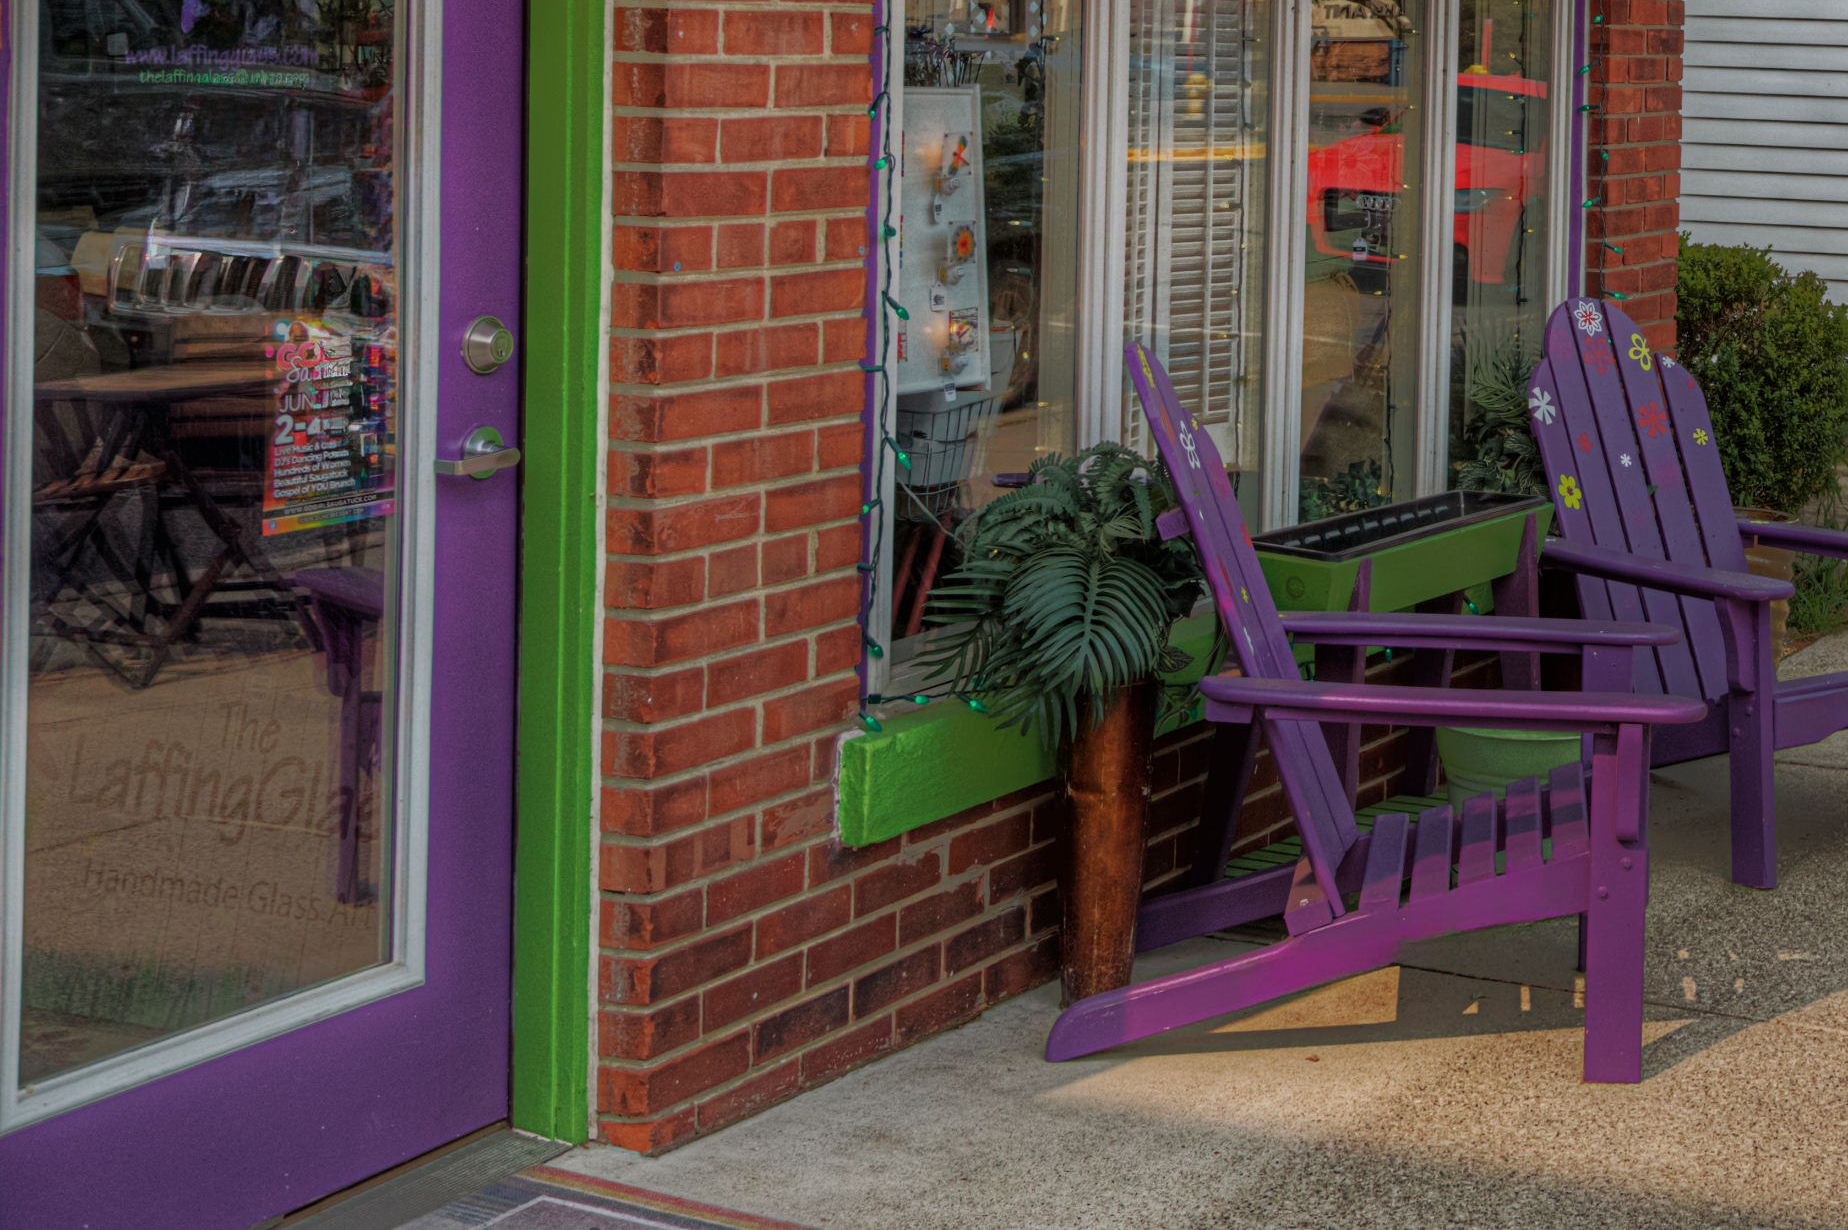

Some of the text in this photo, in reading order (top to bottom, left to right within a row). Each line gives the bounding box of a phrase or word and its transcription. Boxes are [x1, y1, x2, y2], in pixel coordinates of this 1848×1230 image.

[292, 444, 314, 454] Music
[274, 460, 352, 478] Hundreds of Women
[292, 453, 322, 466] Dancing
[273, 478, 356, 500] Gospel of YOU Brunch
[274, 469, 349, 489] Beautiful Saugatuck
[218, 700, 282, 754] The
[83, 859, 376, 928] Handmade Glass Art
